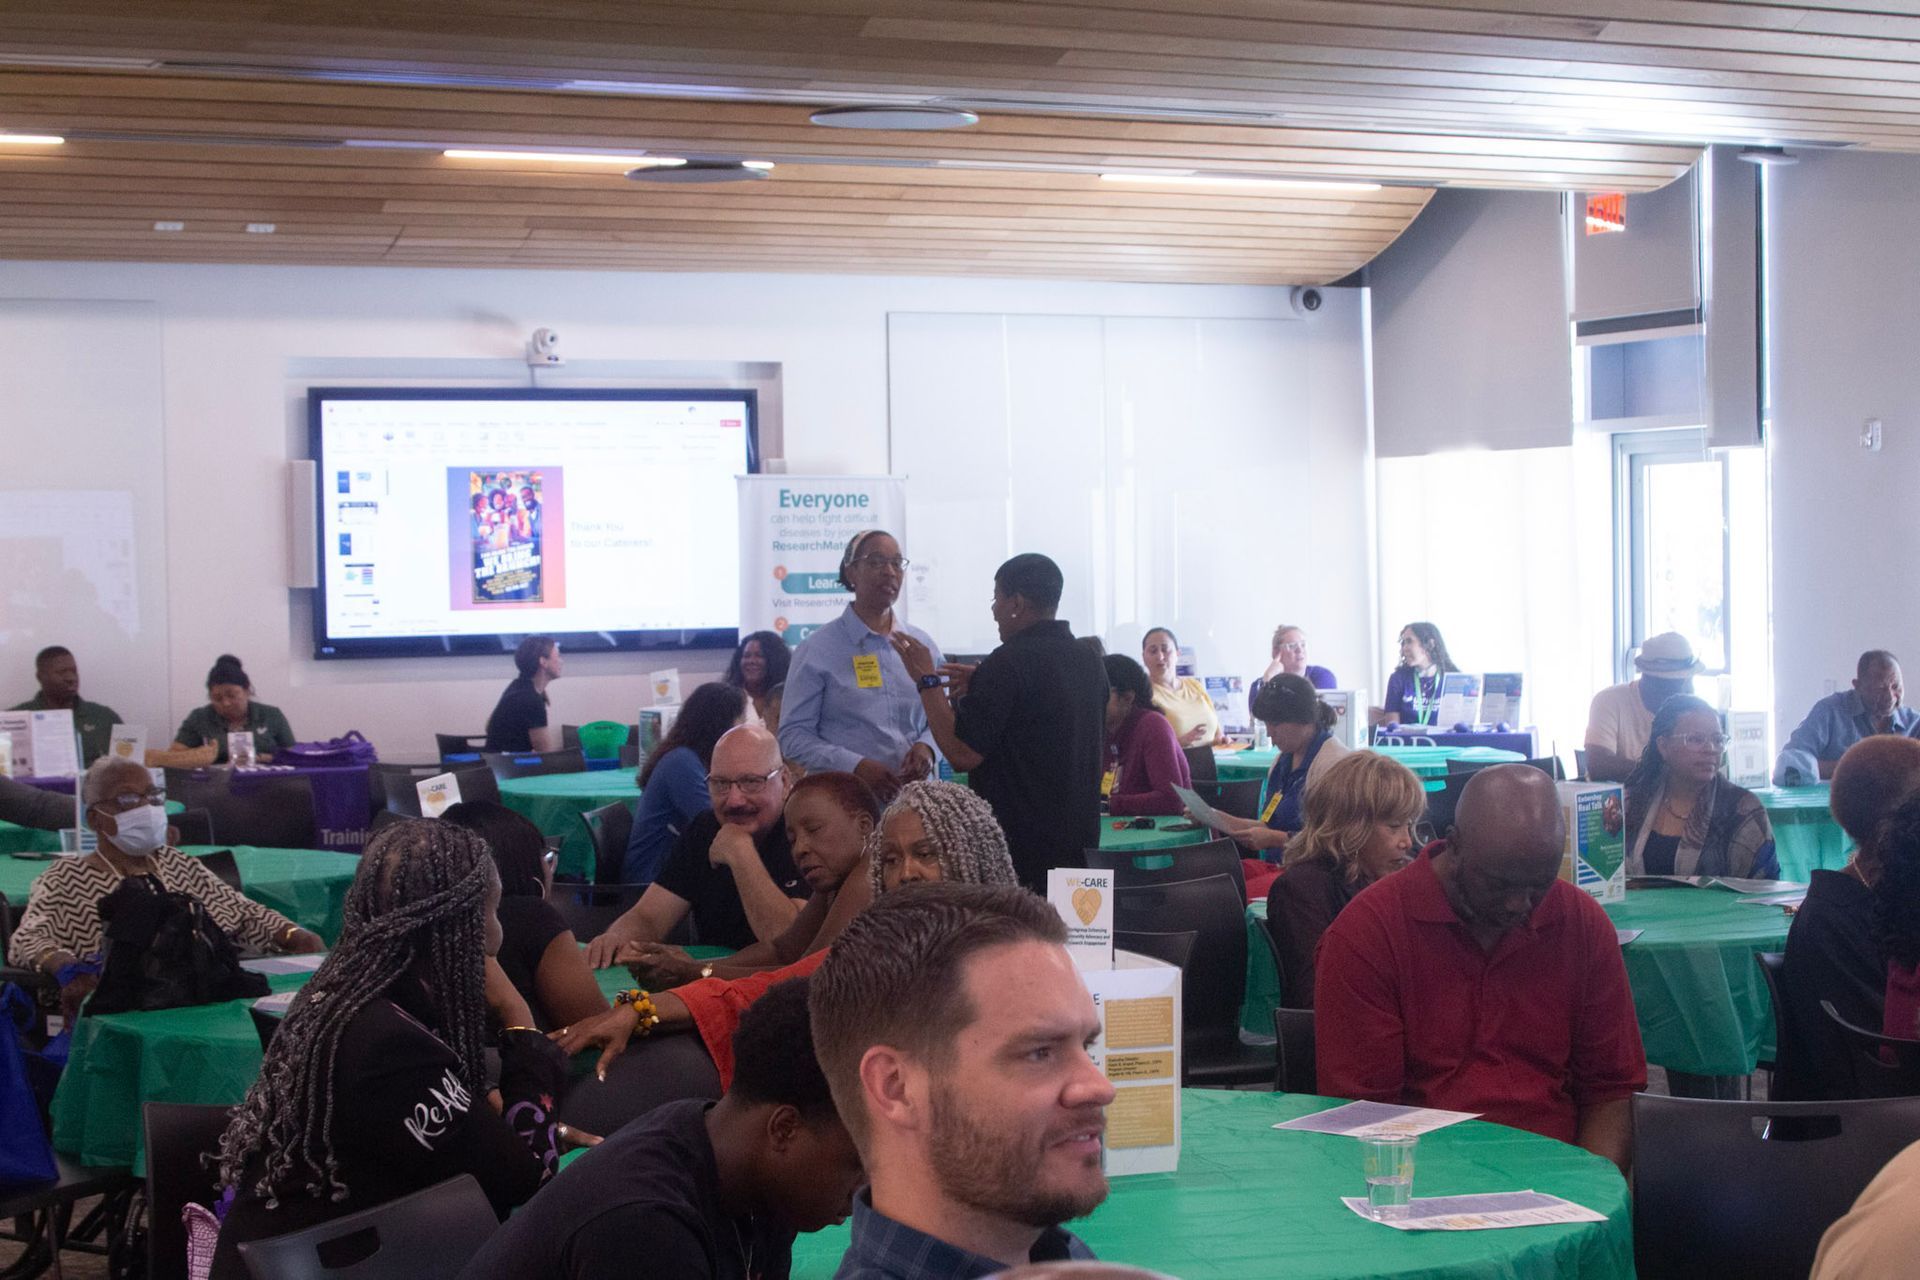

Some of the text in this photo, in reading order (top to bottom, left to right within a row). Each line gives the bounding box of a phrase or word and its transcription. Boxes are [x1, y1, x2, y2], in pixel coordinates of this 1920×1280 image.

[779, 489, 869, 513] Everyone
[770, 513, 879, 525] can help fight difficult
[571, 521, 624, 531] Thank You
[779, 528, 822, 537] diseases
[824, 528, 835, 539] by
[772, 541, 848, 551] ResearchMat
[772, 599, 791, 607] Visit
[320, 828, 364, 845] Traini
[1066, 878, 1108, 888] WE-CARE
